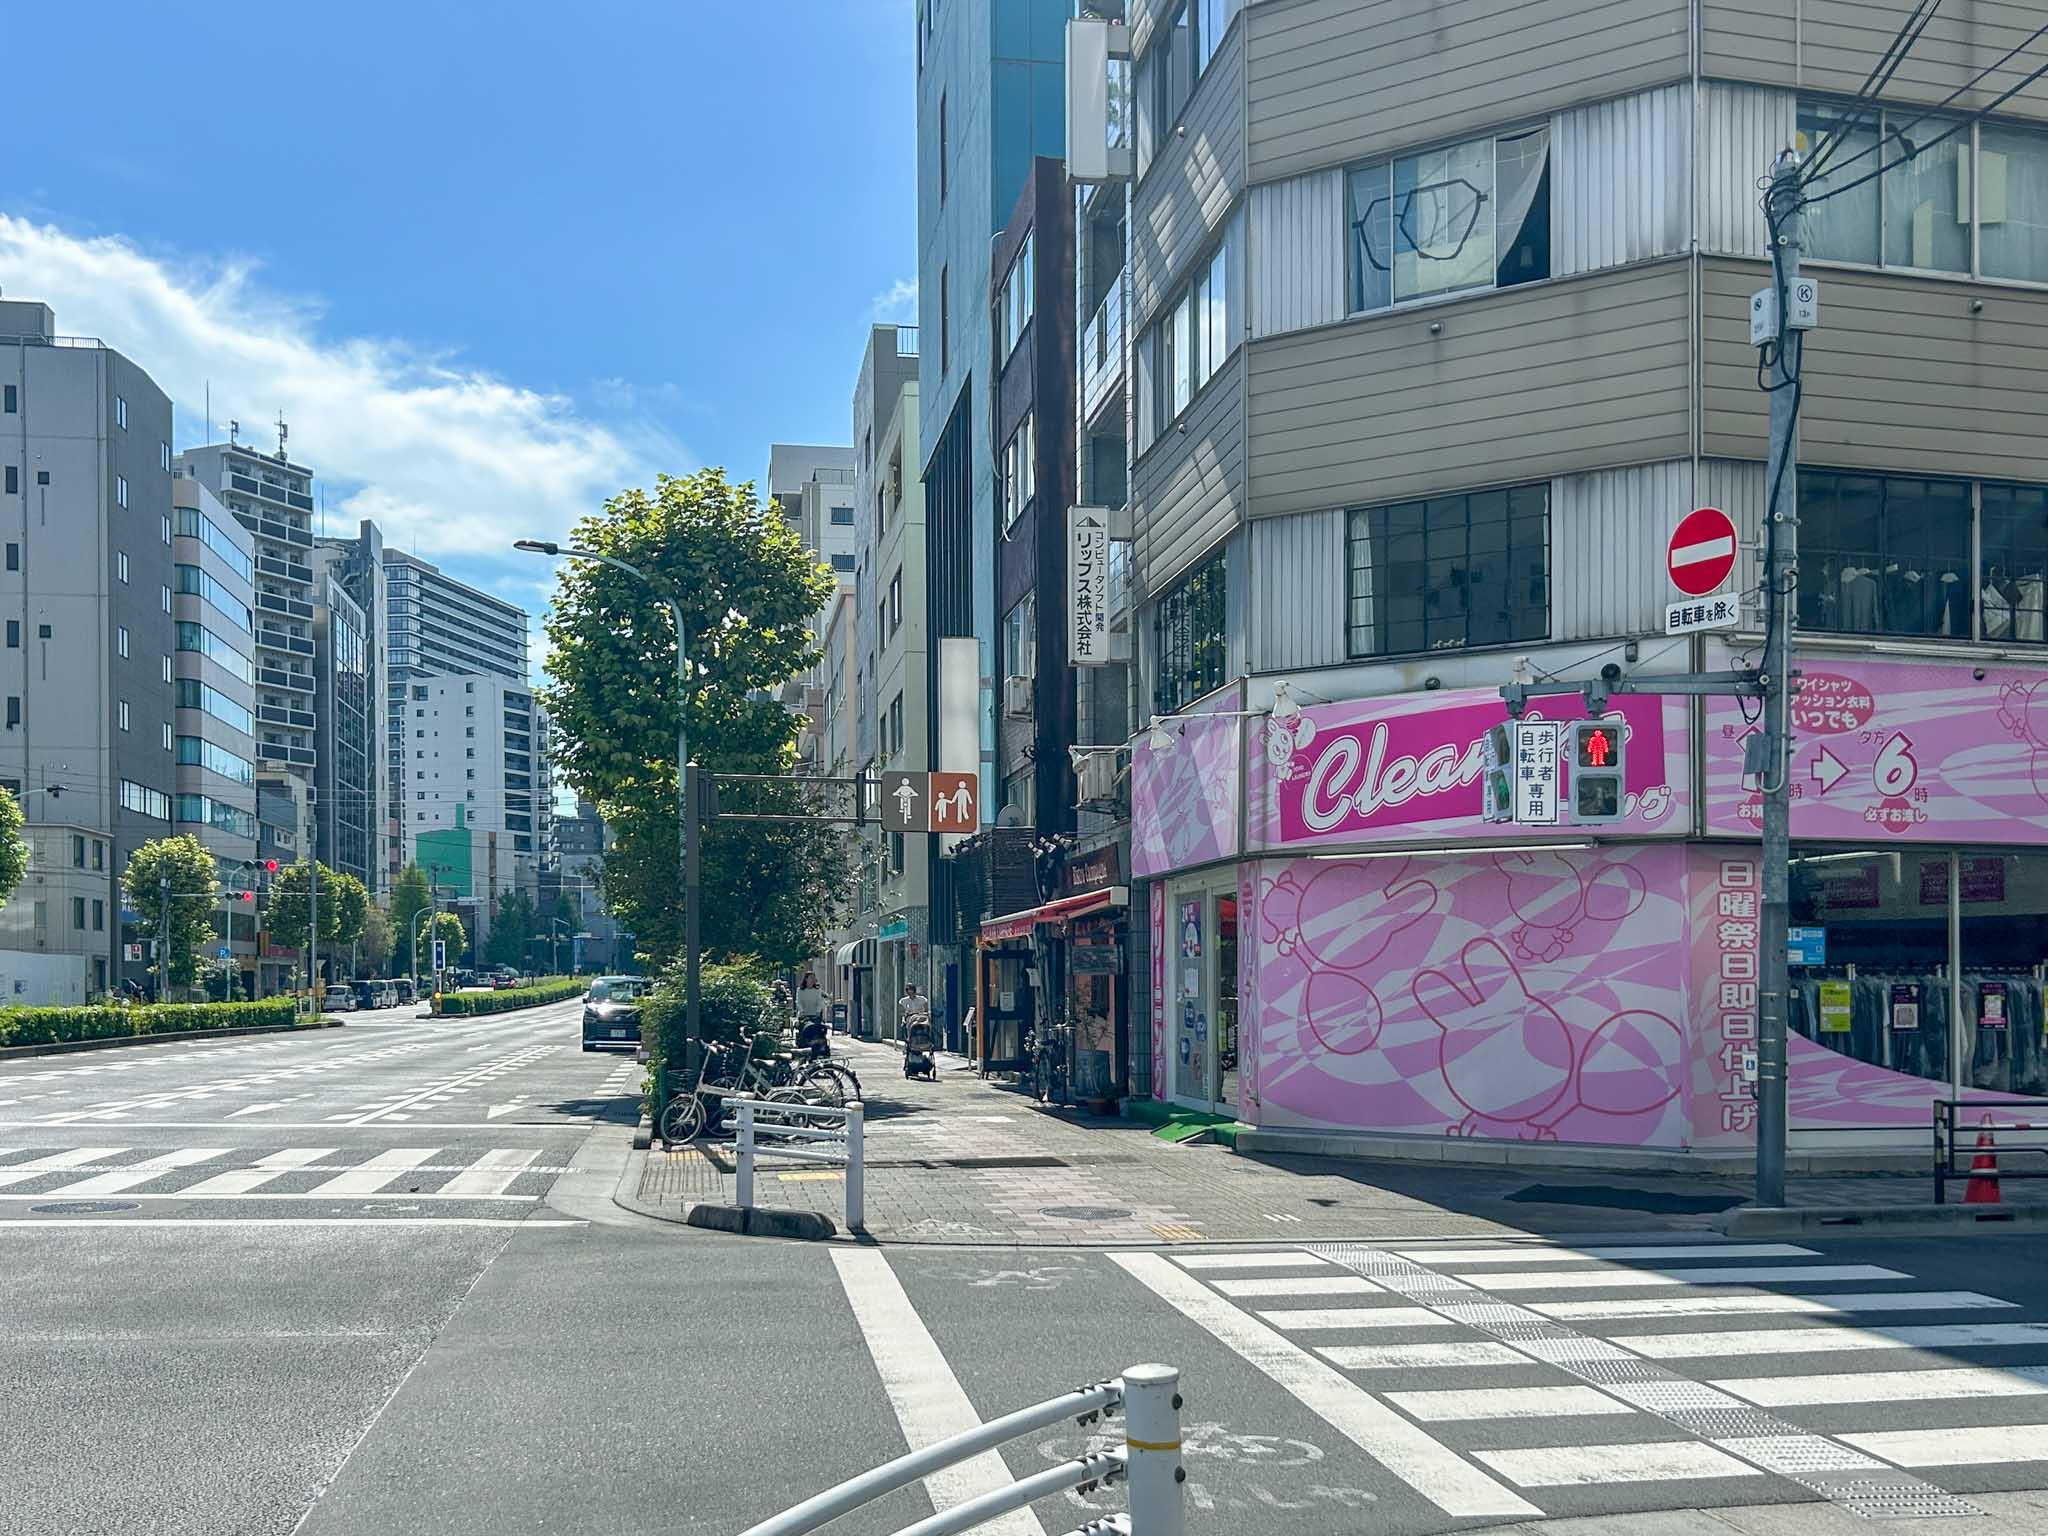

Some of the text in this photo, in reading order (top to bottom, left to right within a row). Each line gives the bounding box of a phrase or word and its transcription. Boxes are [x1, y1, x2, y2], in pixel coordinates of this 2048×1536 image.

[1077, 532, 1093, 656] リップス株式会社
[1095, 531, 1105, 632] コンピュータソフト開発
[1670, 601, 1735, 628] 自転車を除く
[1796, 678, 1852, 693] ワイシャツ
[1790, 694, 1871, 710] ァッション衣料
[1791, 709, 1858, 729] いつでも
[1859, 730, 1885, 746] 夕方
[1520, 731, 1536, 781] 自転車
[1538, 731, 1554, 781] 歩行者
[1872, 731, 1919, 798] 6
[1528, 783, 1545, 817] 専用
[1789, 784, 1803, 800] 時
[1914, 787, 1929, 803] 時
[1864, 806, 1928, 824] 必ずお渡し
[1717, 859, 1760, 1132] 日曜祭日即日仕上げ
